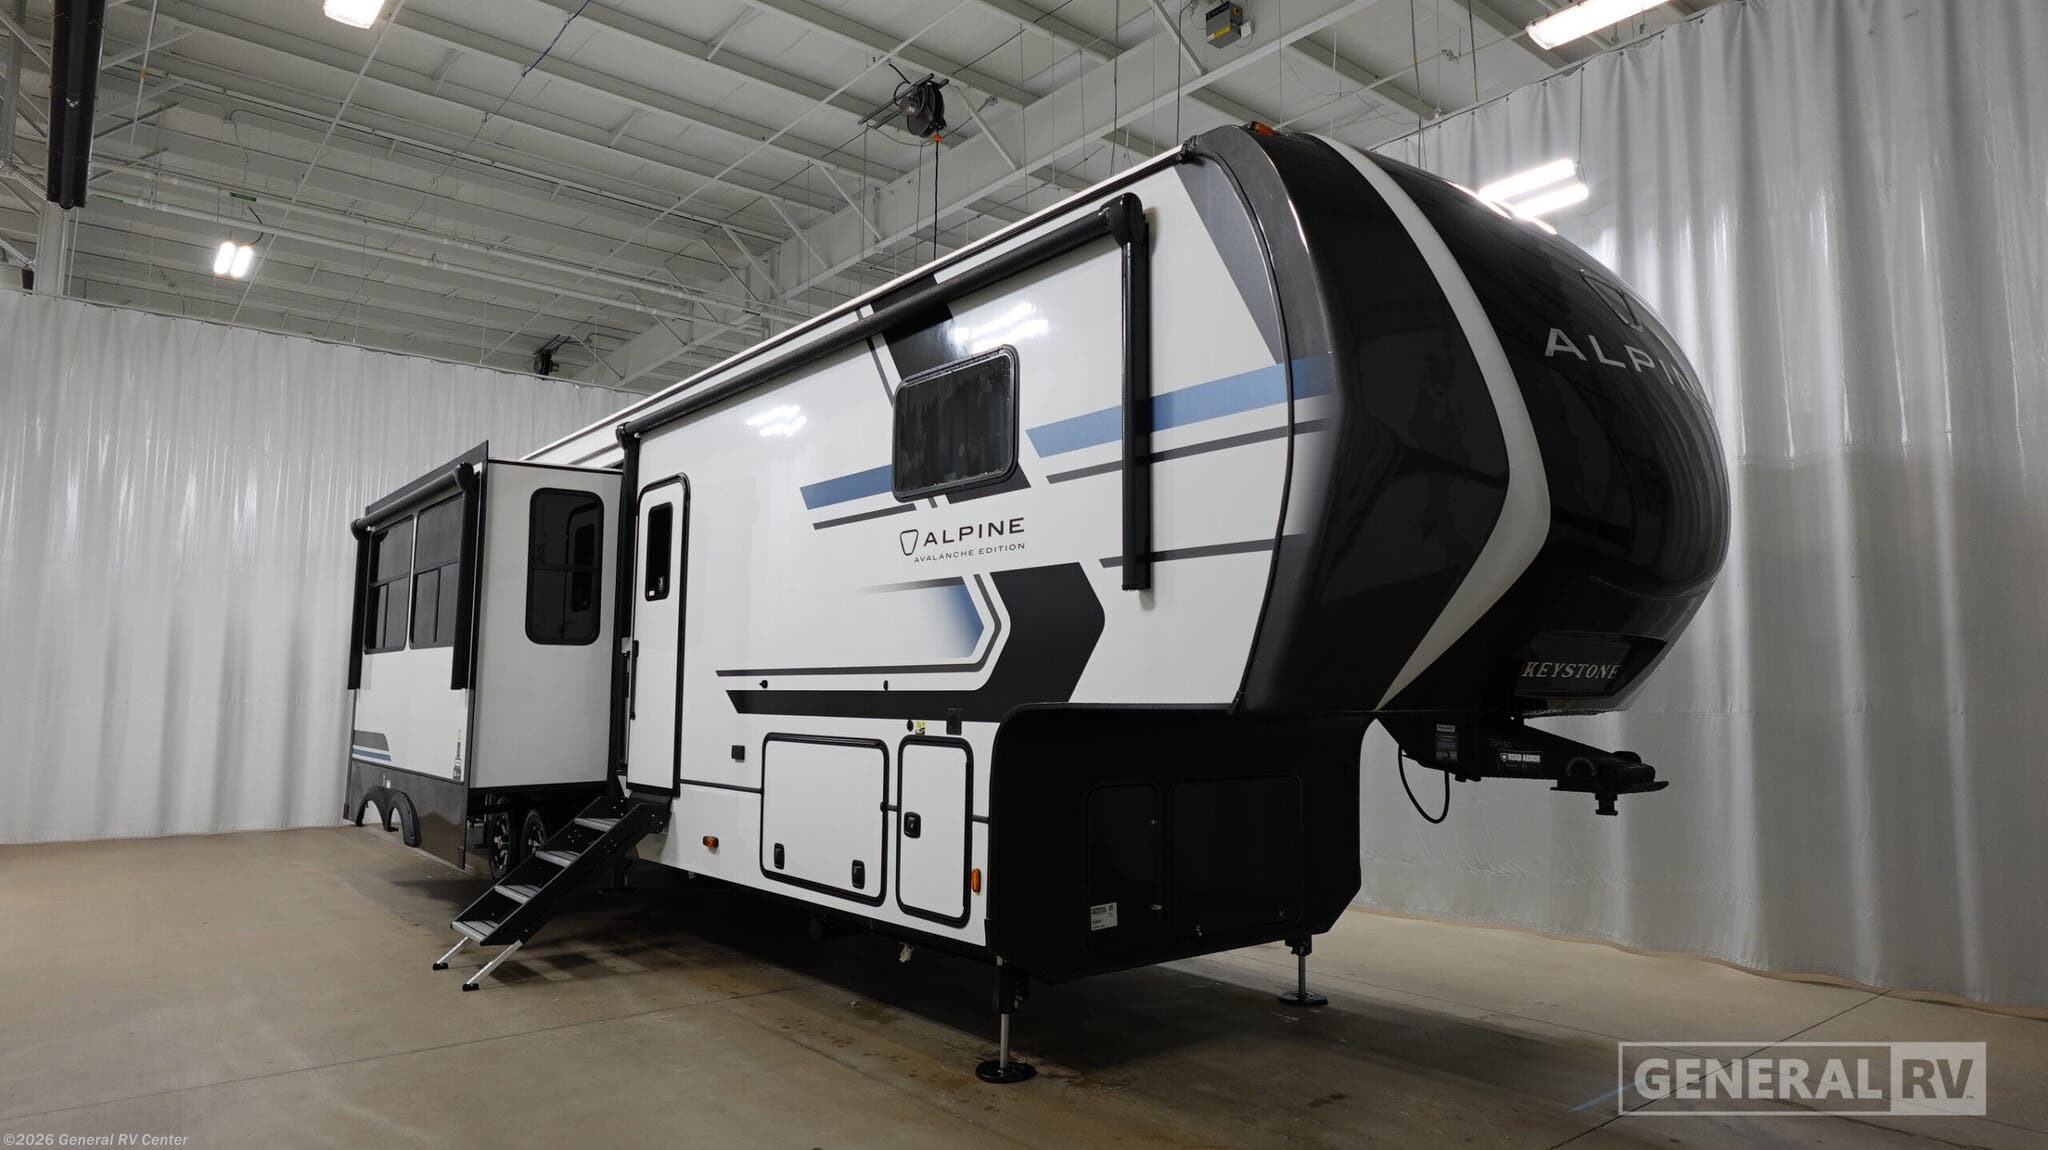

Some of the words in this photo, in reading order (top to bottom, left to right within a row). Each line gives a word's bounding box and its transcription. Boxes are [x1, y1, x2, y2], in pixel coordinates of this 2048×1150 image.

[923, 517, 1025, 547] ALPINE
[913, 549, 974, 563] AVALANCHE
[978, 543, 1025, 555] EDITION
[1522, 661, 1621, 679] KEYSTONE
